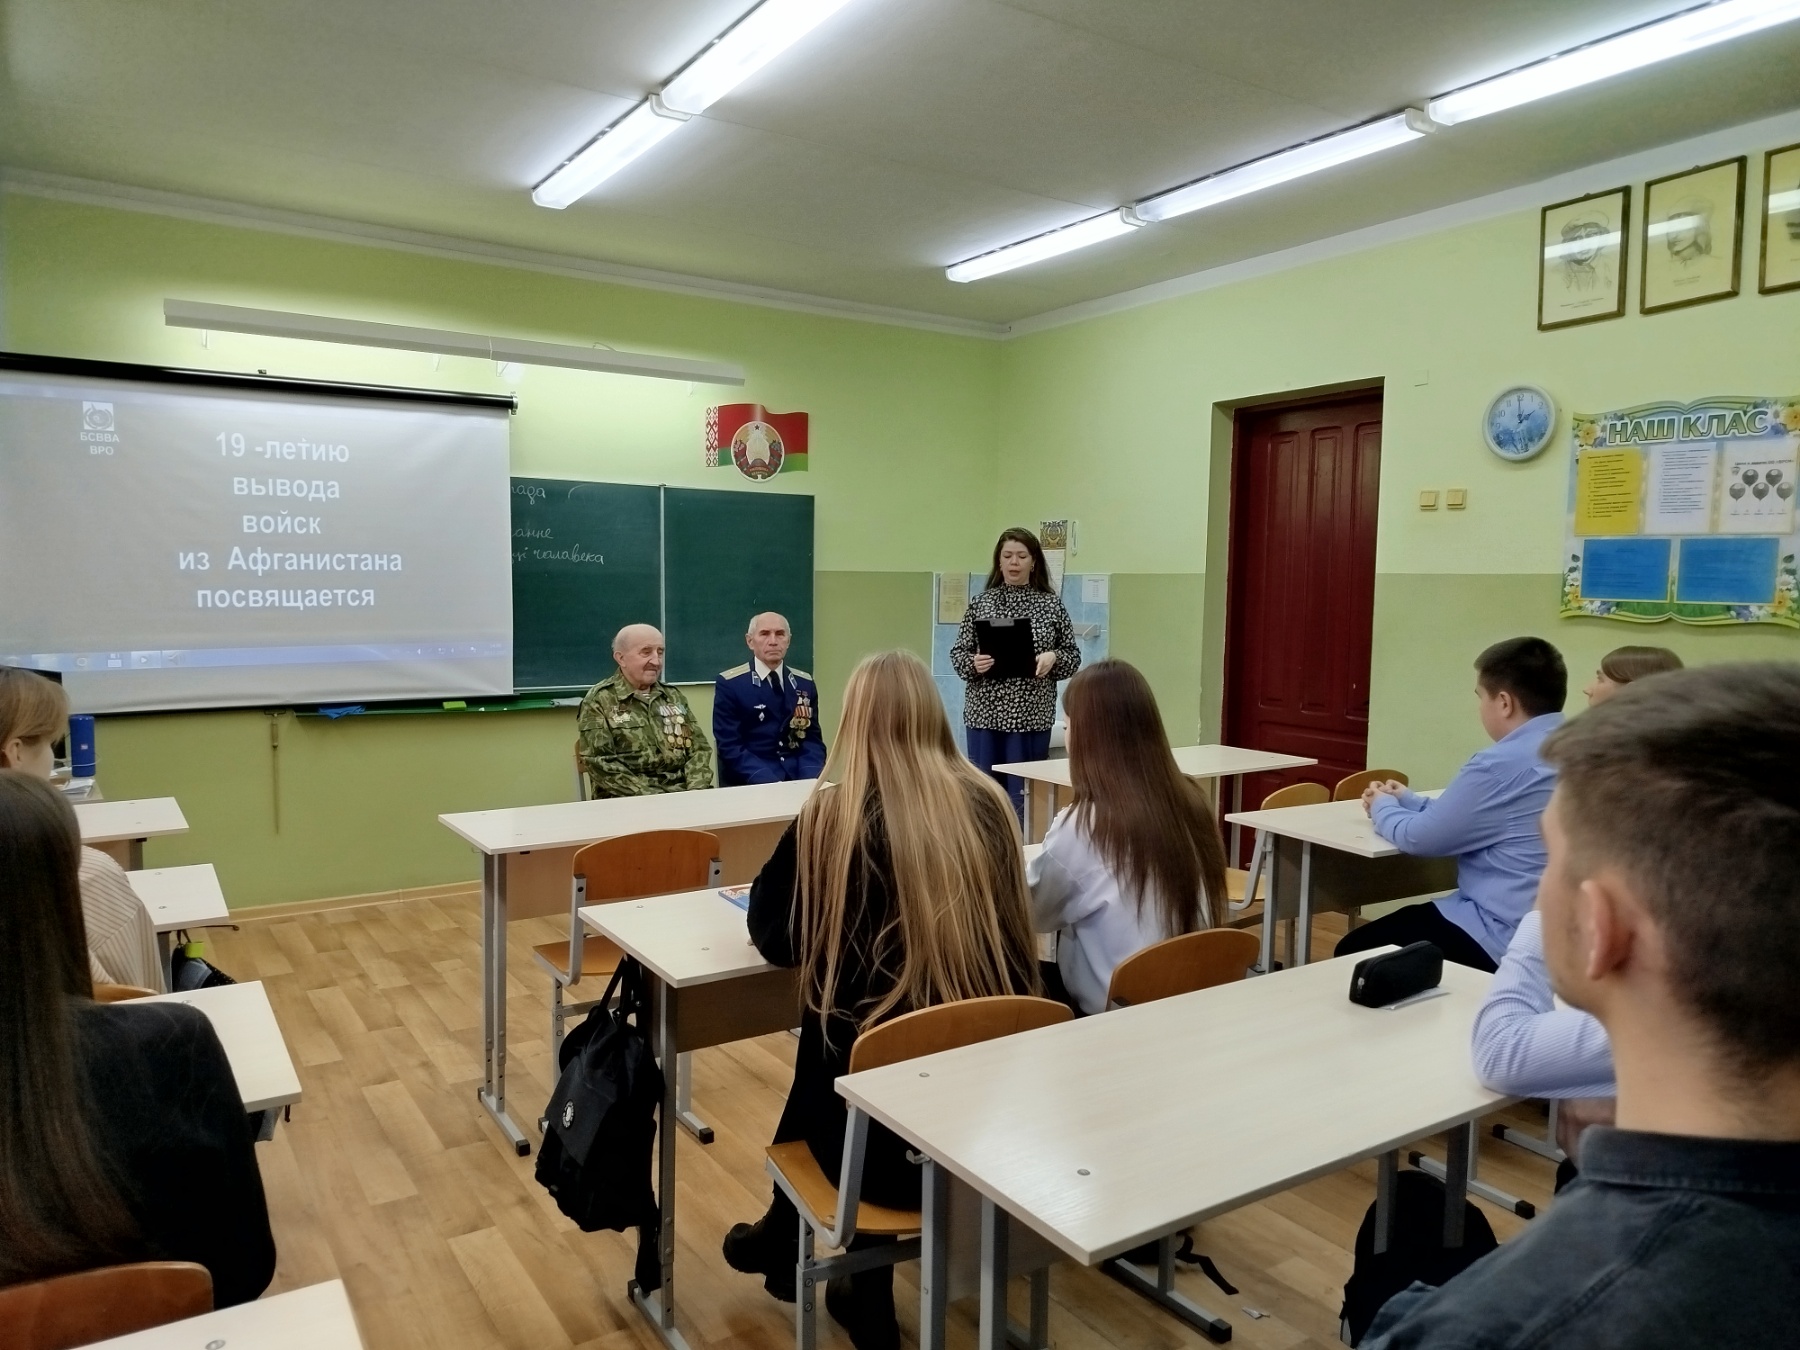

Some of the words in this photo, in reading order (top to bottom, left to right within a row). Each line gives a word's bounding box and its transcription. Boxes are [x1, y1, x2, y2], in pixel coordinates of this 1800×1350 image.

[80, 431, 120, 443] БСВВА
[1608, 417, 1676, 444] НАШ
[1681, 410, 1769, 439] КЛАС
[90, 445, 114, 456] ВРО
[215, 431, 246, 458] 19
[255, 439, 350, 463] -летию
[233, 476, 340, 502] вывода
[242, 509, 321, 534] войск
[512, 527, 554, 539] анне
[179, 551, 210, 570] из
[227, 546, 403, 576] Афганистана
[196, 588, 375, 610] посвящается
